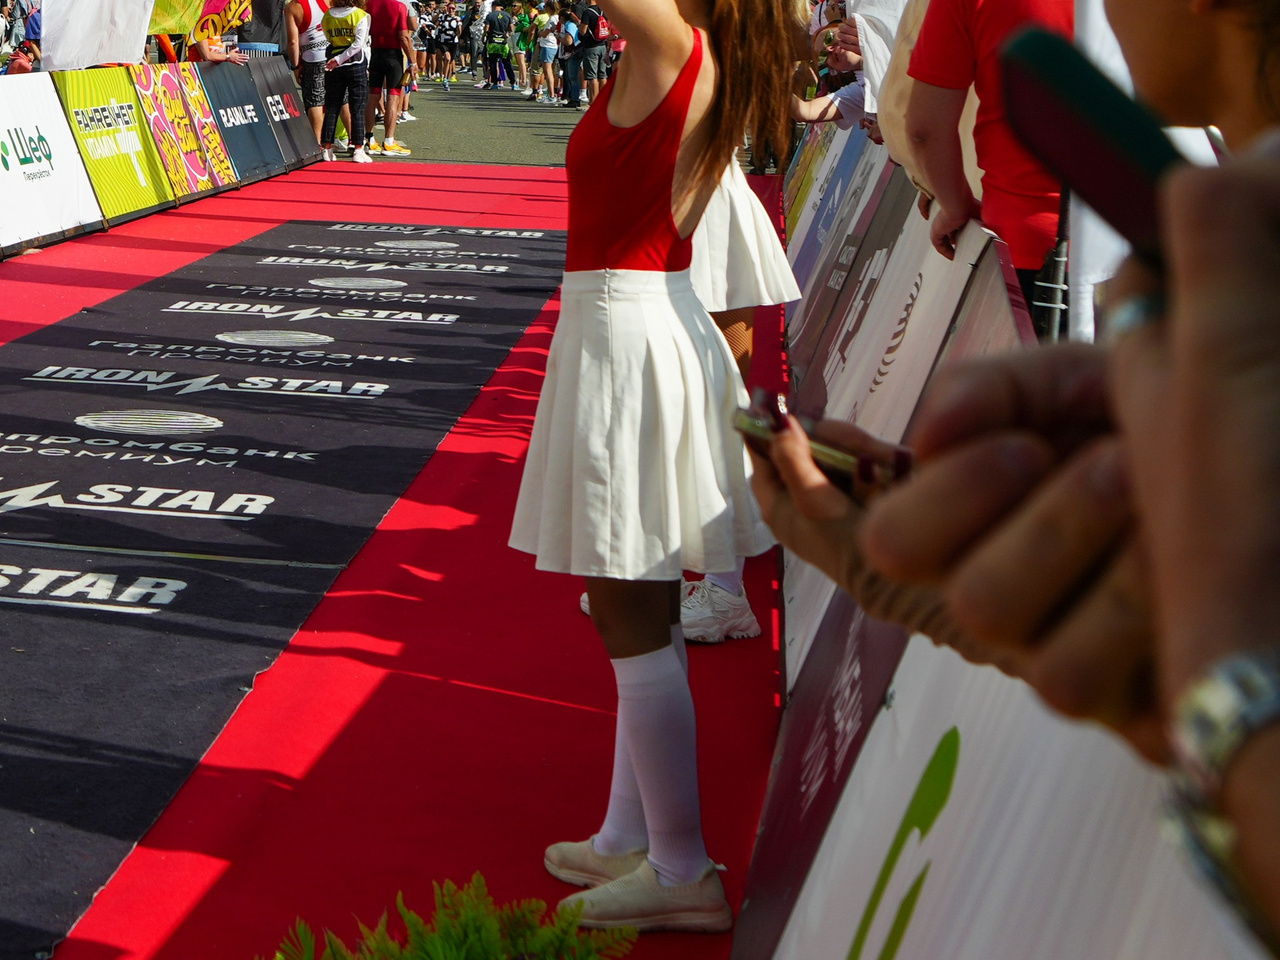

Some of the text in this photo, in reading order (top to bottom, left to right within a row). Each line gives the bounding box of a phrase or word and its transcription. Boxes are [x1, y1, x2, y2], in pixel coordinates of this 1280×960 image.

[73, 103, 138, 134] FAHRENHEIT
[6, 125, 54, 171] Шеф
[328, 223, 545, 239] IRON STAR
[261, 256, 510, 273] IRON STAR
[168, 300, 461, 322] IRON STAR
[88, 340, 417, 363] Газпромбанк
[126, 349, 354, 368] Премиум
[32, 365, 391, 396] IRON STAR
[75, 483, 276, 515] STAR
